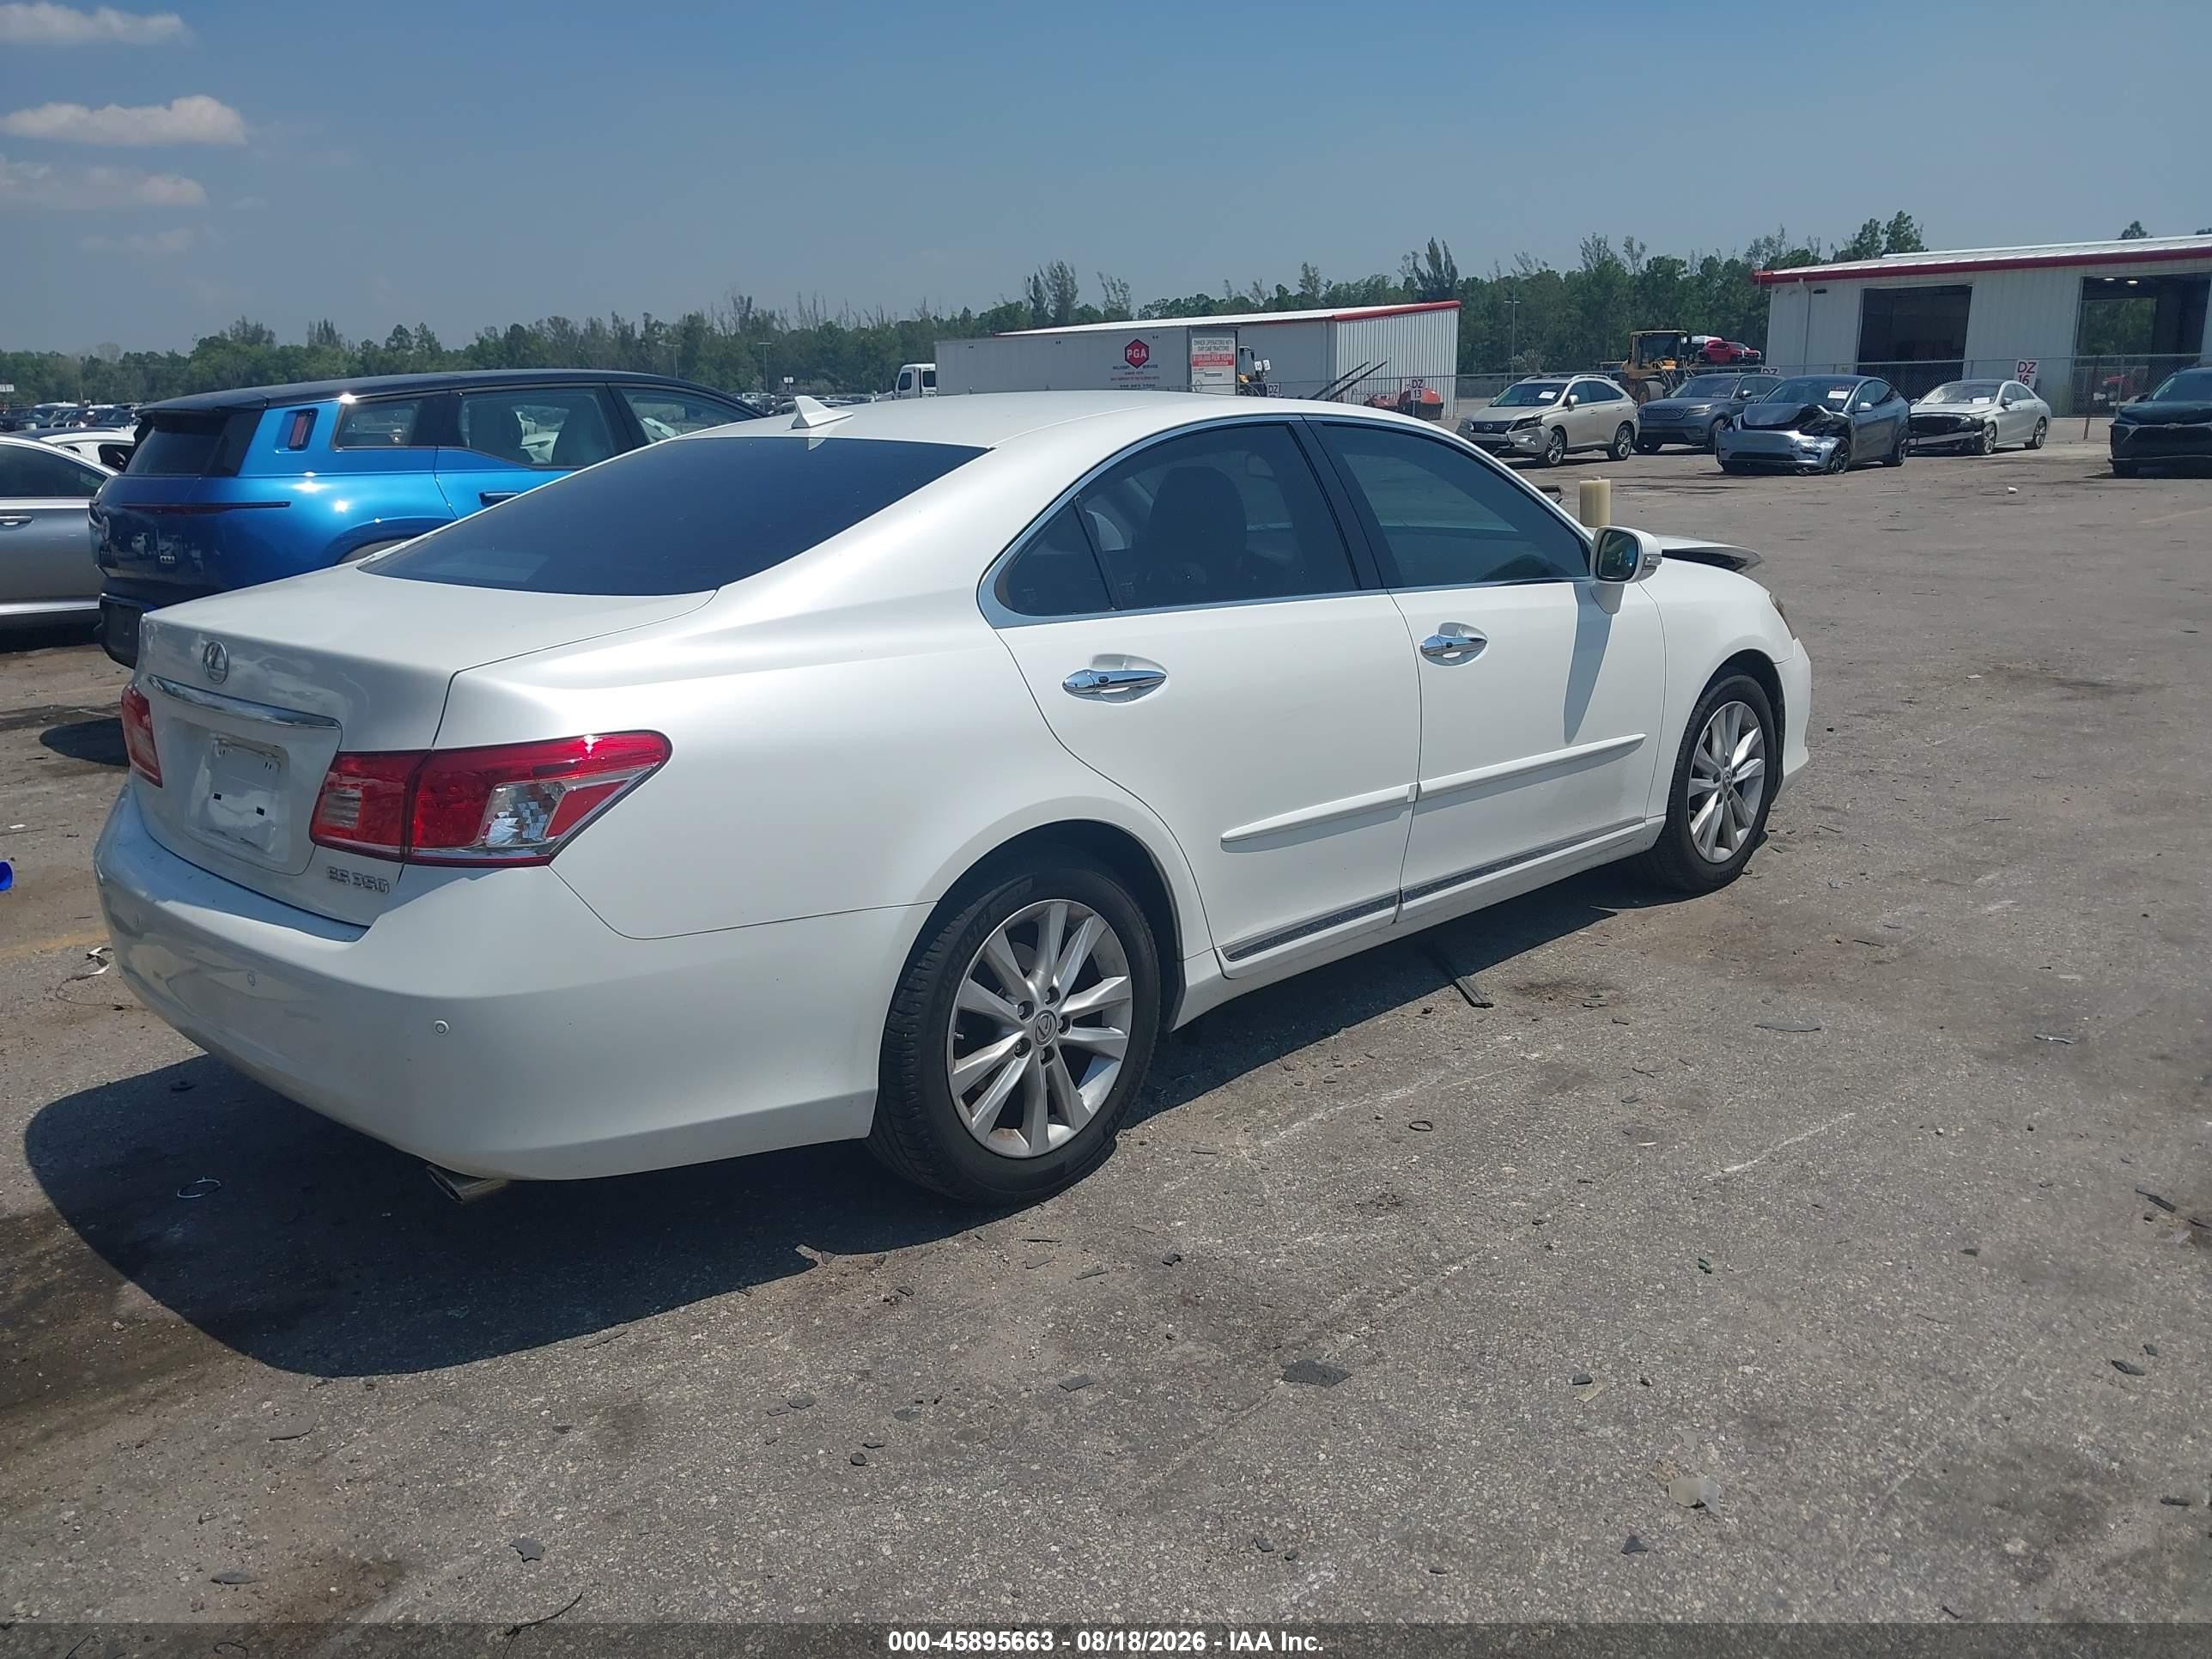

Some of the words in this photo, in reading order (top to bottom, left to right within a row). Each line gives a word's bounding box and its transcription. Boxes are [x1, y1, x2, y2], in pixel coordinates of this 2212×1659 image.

[1127, 348, 1146, 359] PGA
[2018, 362, 2036, 374] DZ
[1412, 380, 1423, 388] DZ
[2020, 374, 2029, 385] 16
[1268, 385, 1278, 393] DZ
[1413, 390, 1422, 398] 13
